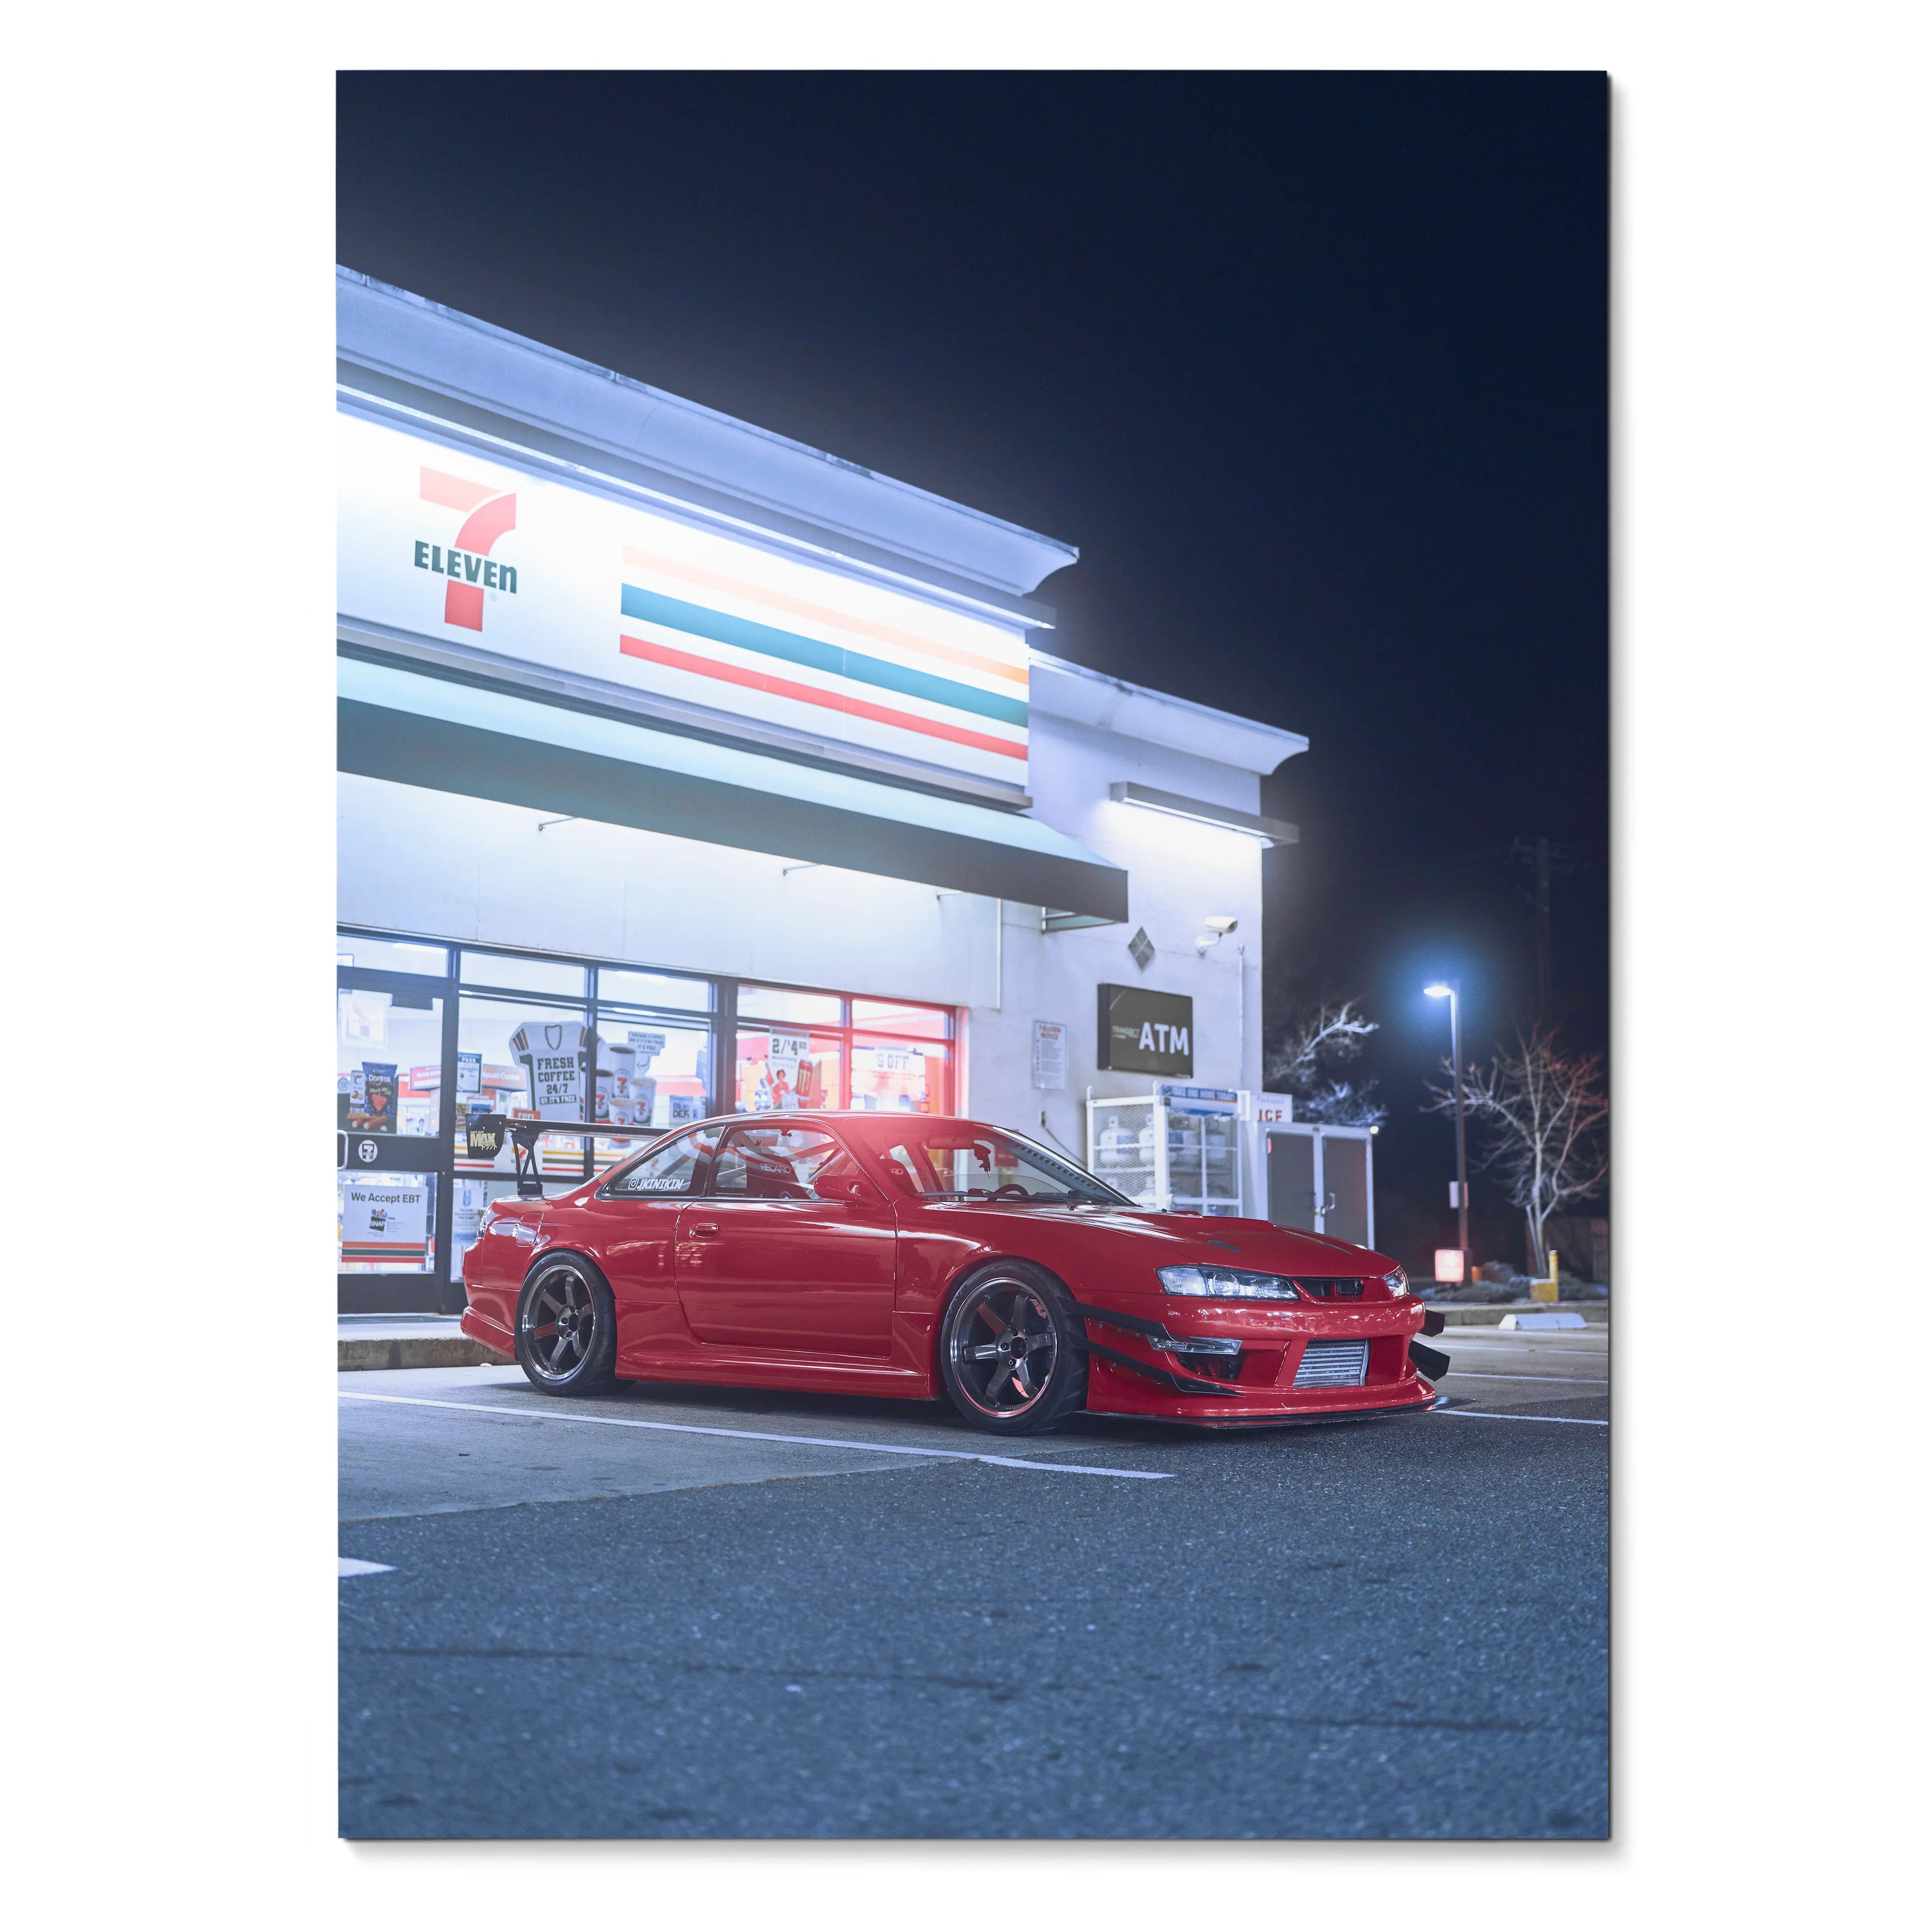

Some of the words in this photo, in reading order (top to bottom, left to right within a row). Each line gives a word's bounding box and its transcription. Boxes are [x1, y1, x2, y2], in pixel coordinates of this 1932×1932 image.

[420, 465, 516, 632] 7
[1139, 1022, 1189, 1056] ATM
[537, 1057, 574, 1070] FRESH
[887, 1054, 909, 1069] OFF
[369, 1074, 391, 1082] Doritos
[538, 1071, 575, 1082] COFFEE
[546, 1083, 568, 1094] 24/7
[470, 1133, 496, 1147] MAX
[760, 1163, 792, 1174] RECARO
[637, 1179, 684, 1189] JKINIKIN
[351, 1192, 366, 1201] We
[368, 1193, 400, 1204] Accept
[402, 1194, 421, 1203] EBT
